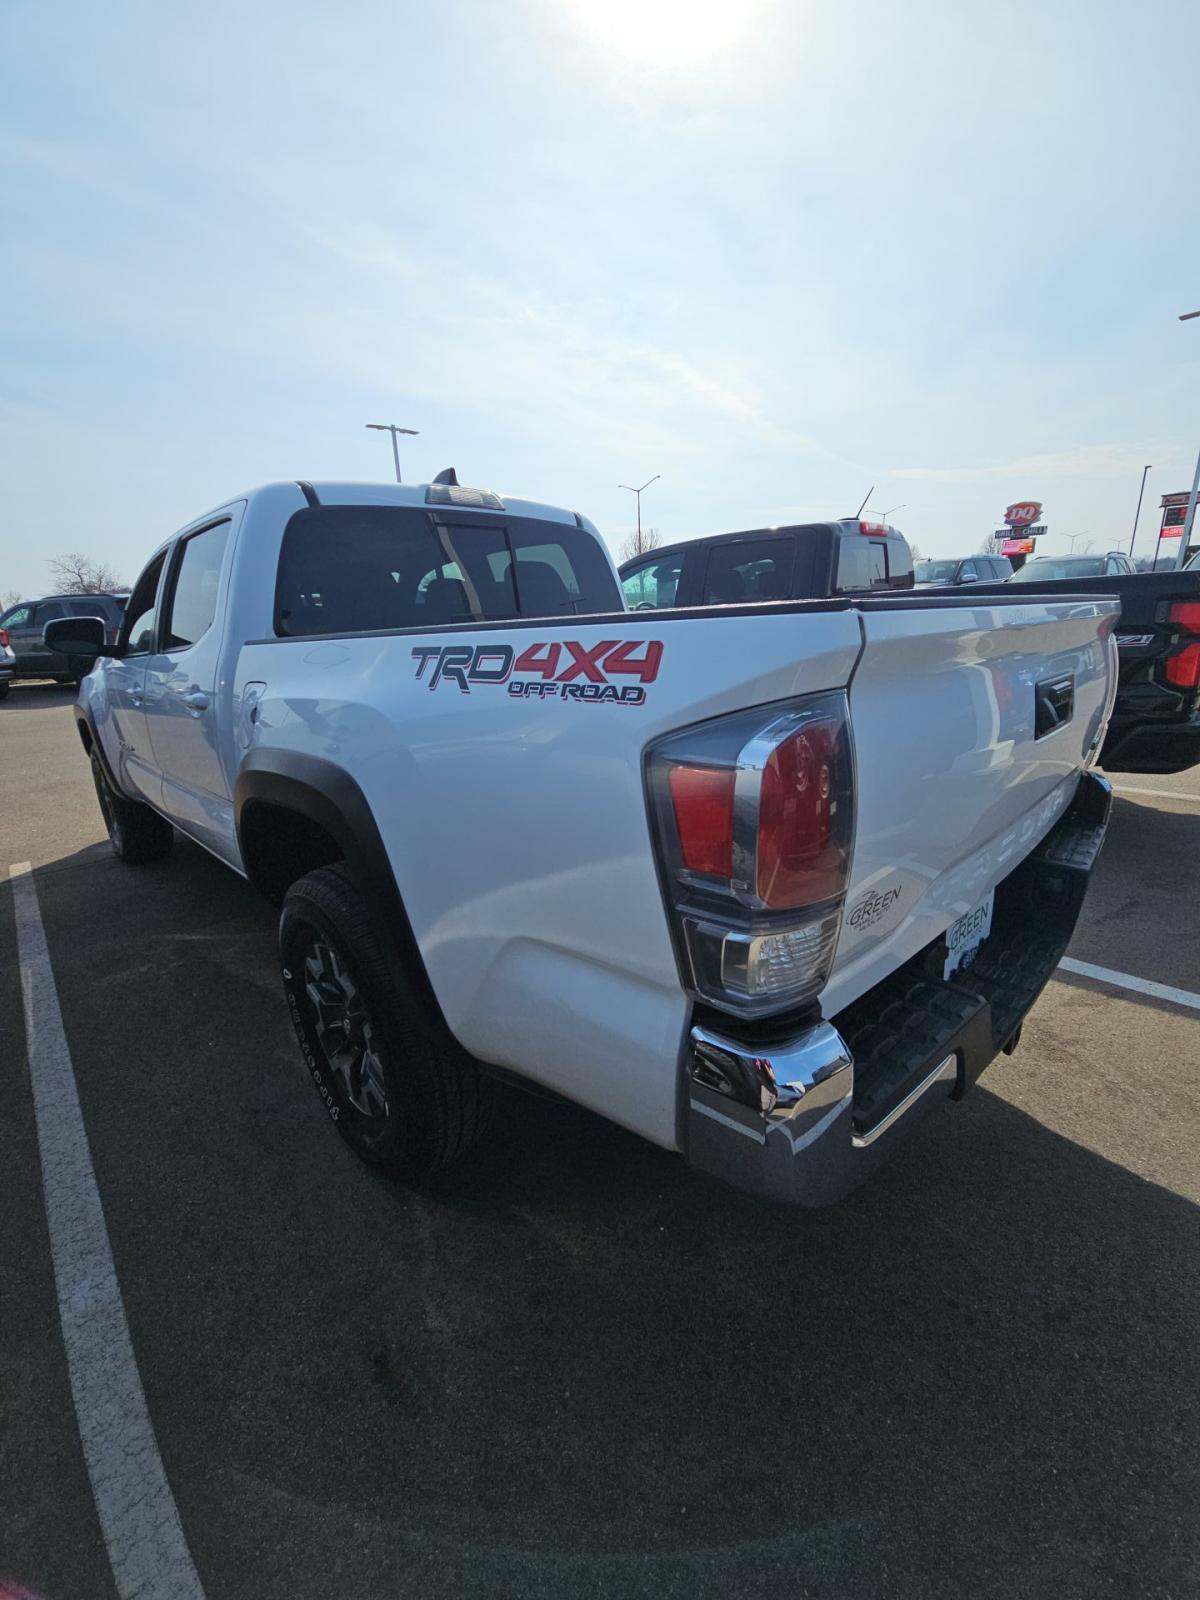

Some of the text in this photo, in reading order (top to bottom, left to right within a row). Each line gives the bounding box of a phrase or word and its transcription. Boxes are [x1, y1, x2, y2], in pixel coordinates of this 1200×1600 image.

[1010, 506, 1036, 520] DQ
[1022, 526, 1047, 535] CHILL
[411, 639, 664, 694] TRD 4X4
[507, 681, 646, 705] OFF ROAD
[846, 885, 902, 926] GREEN
[950, 902, 989, 950] GREEN
